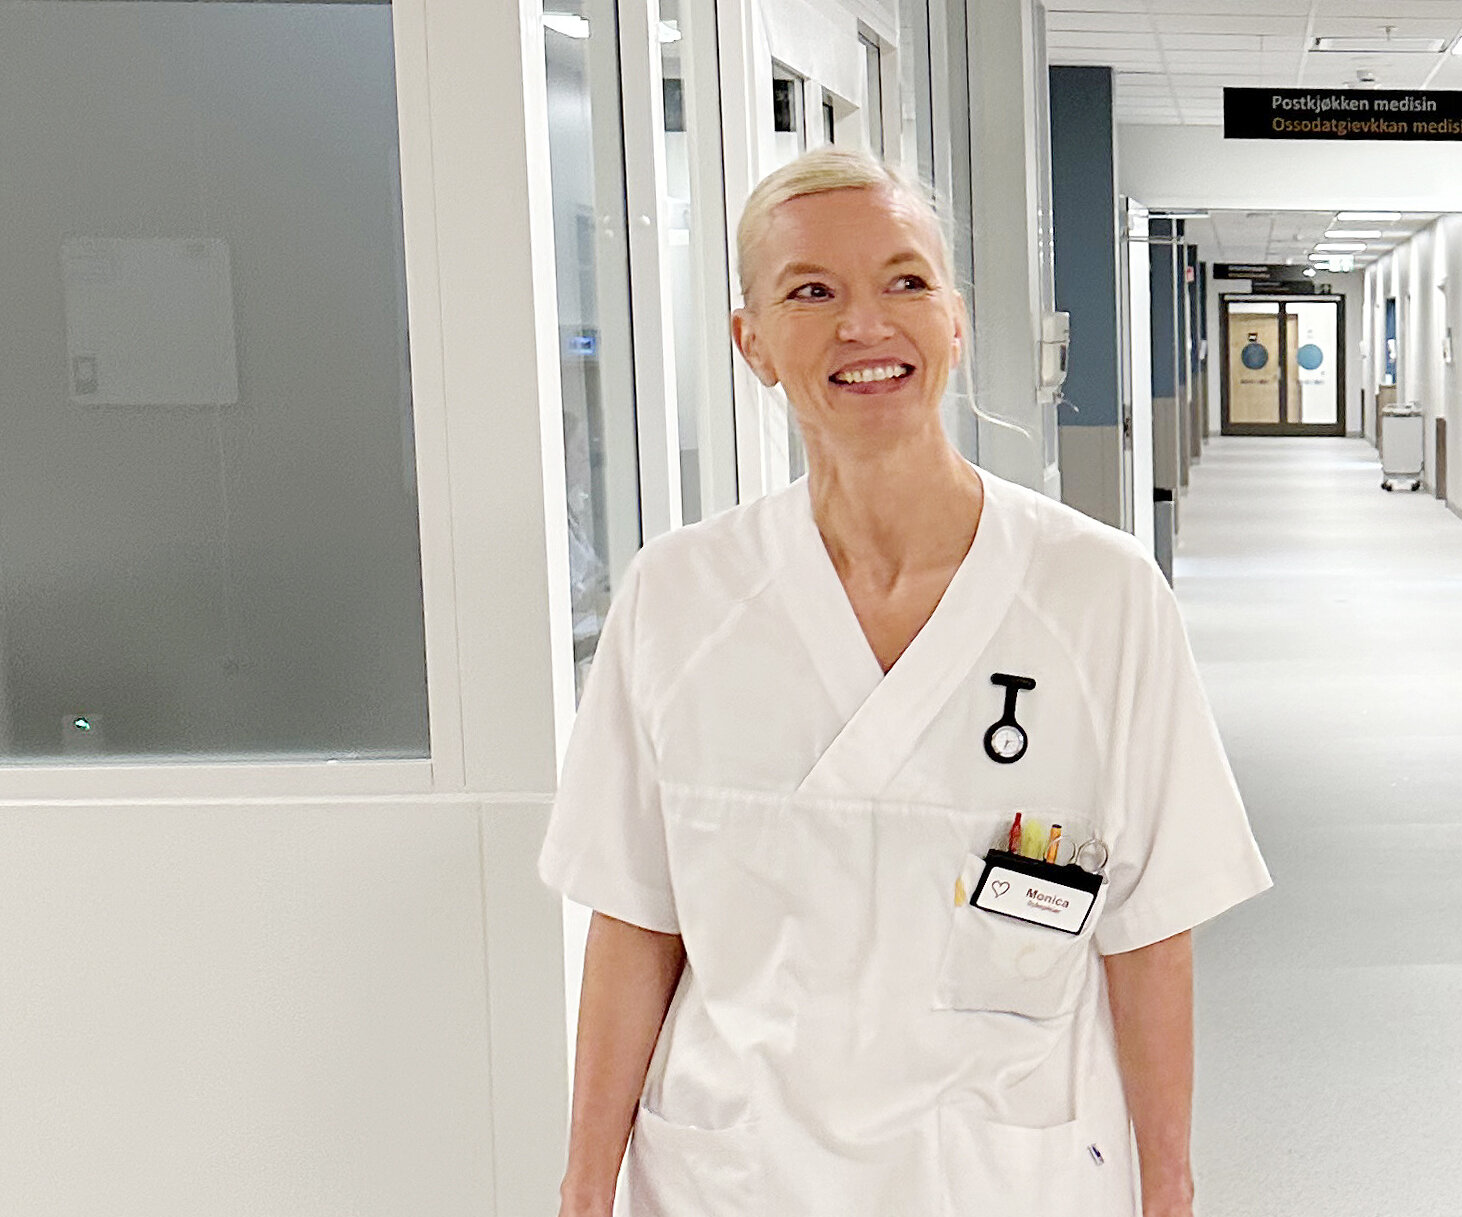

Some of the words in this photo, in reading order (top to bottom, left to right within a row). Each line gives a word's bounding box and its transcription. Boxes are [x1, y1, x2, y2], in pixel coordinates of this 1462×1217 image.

[1272, 95, 1369, 113] Postkjøkken
[1374, 97, 1437, 112] medisin
[1026, 888, 1070, 908] Monica
